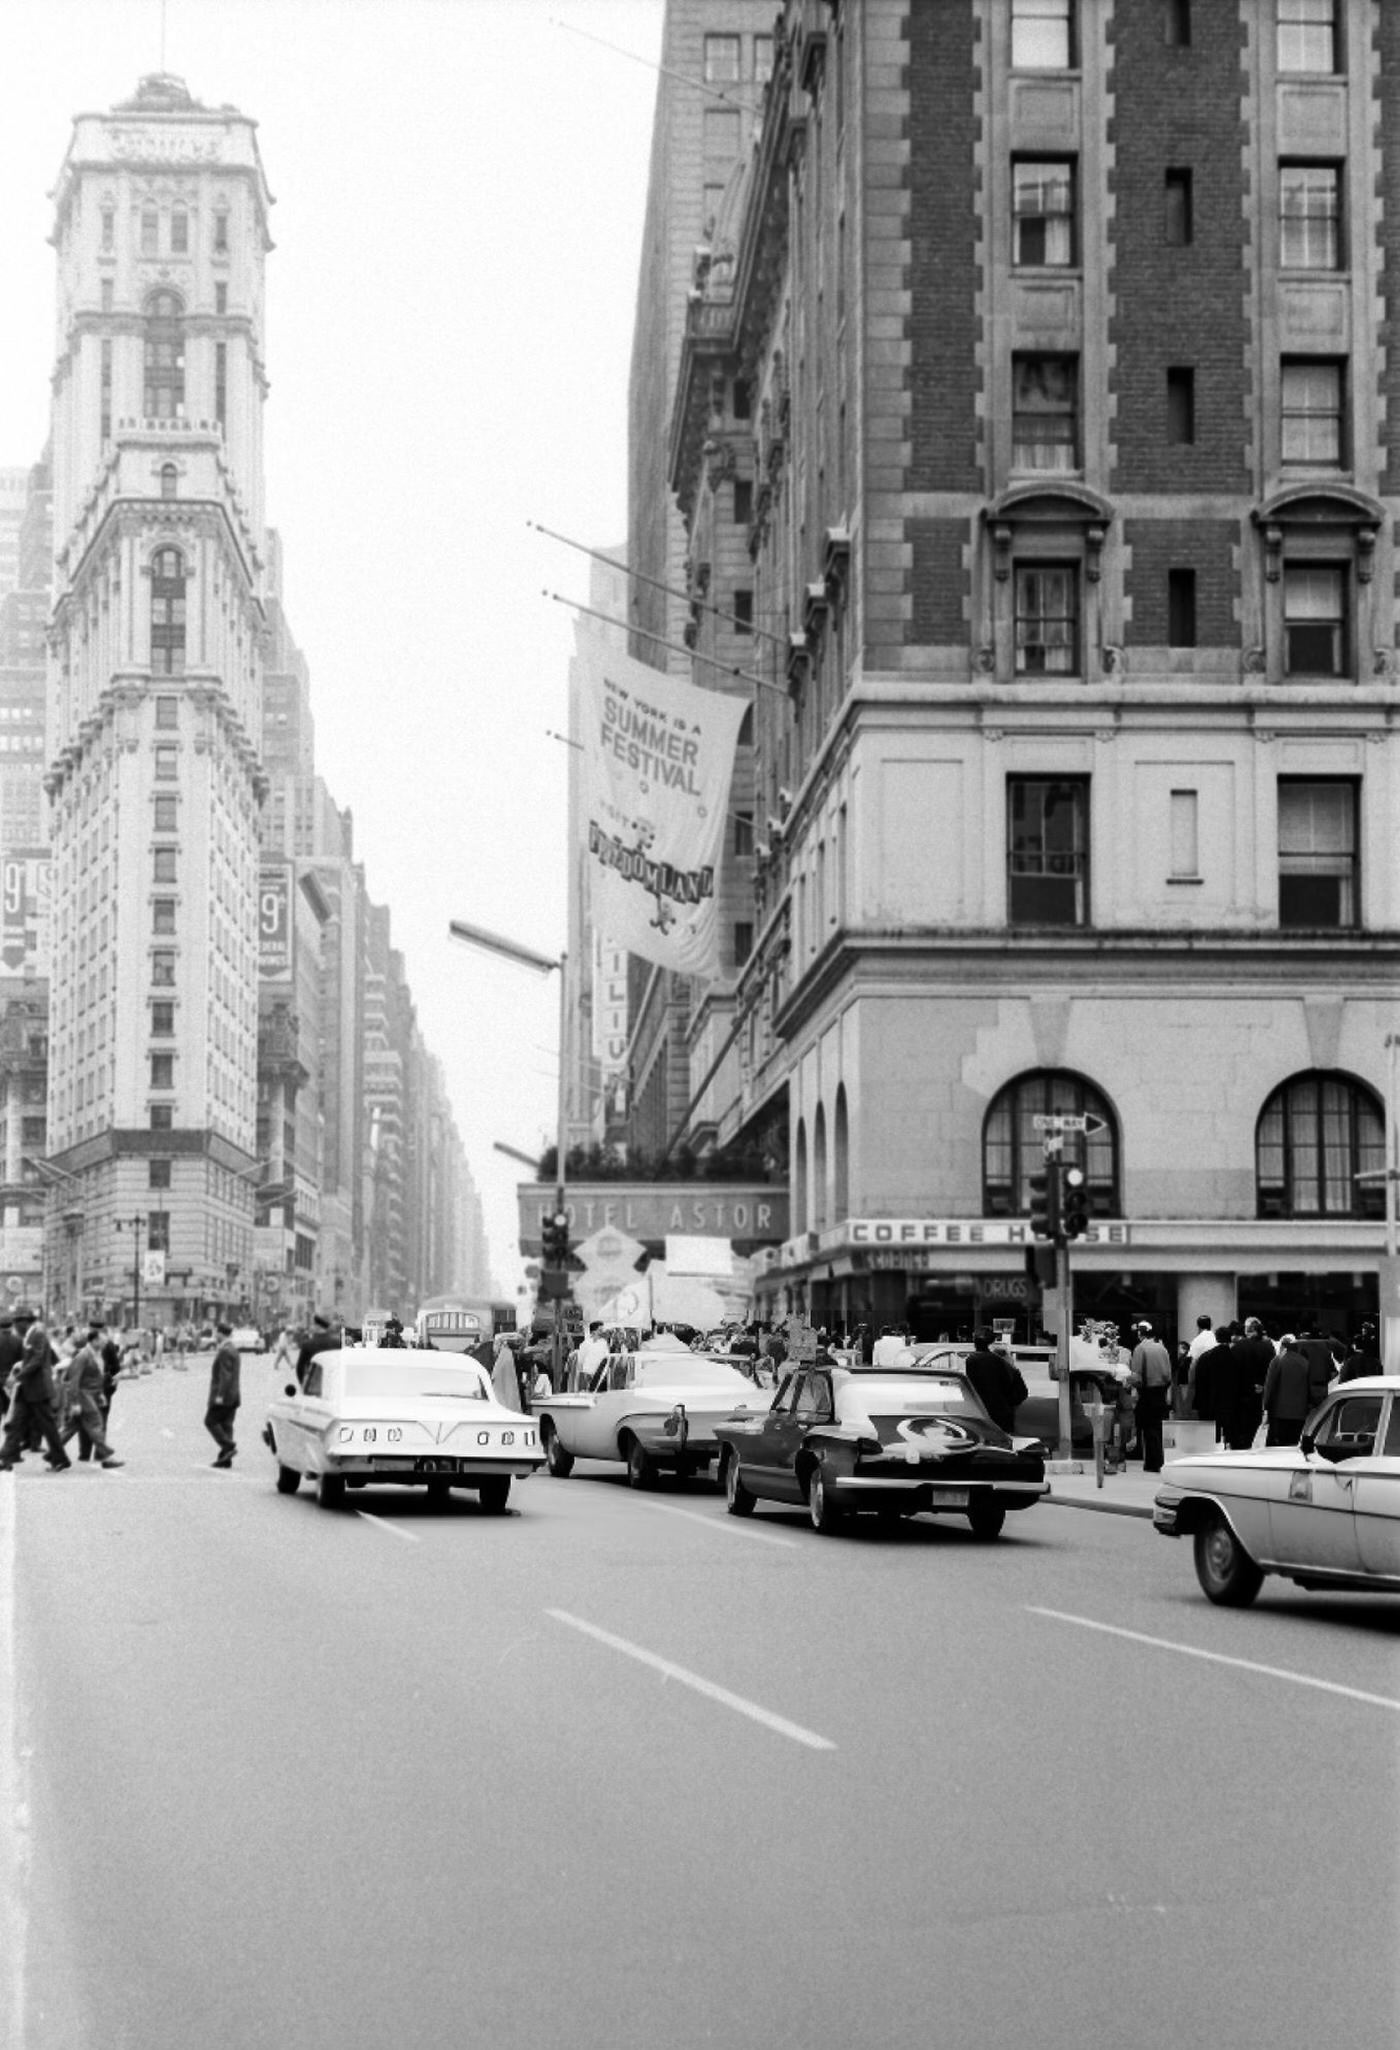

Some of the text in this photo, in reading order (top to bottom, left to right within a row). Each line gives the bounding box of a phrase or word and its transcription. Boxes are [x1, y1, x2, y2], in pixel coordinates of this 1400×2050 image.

[603, 678, 701, 736] NEW YORK IS A
[604, 696, 699, 767] SUMMER
[600, 722, 702, 797] FESTIVAL
[261, 893, 279, 935] 9
[1063, 1118, 1083, 1127] WAY
[671, 1204, 772, 1228] ASTOR
[853, 1224, 1123, 1242] COFFEE HSE
[983, 1279, 1027, 1298] DRUGS
